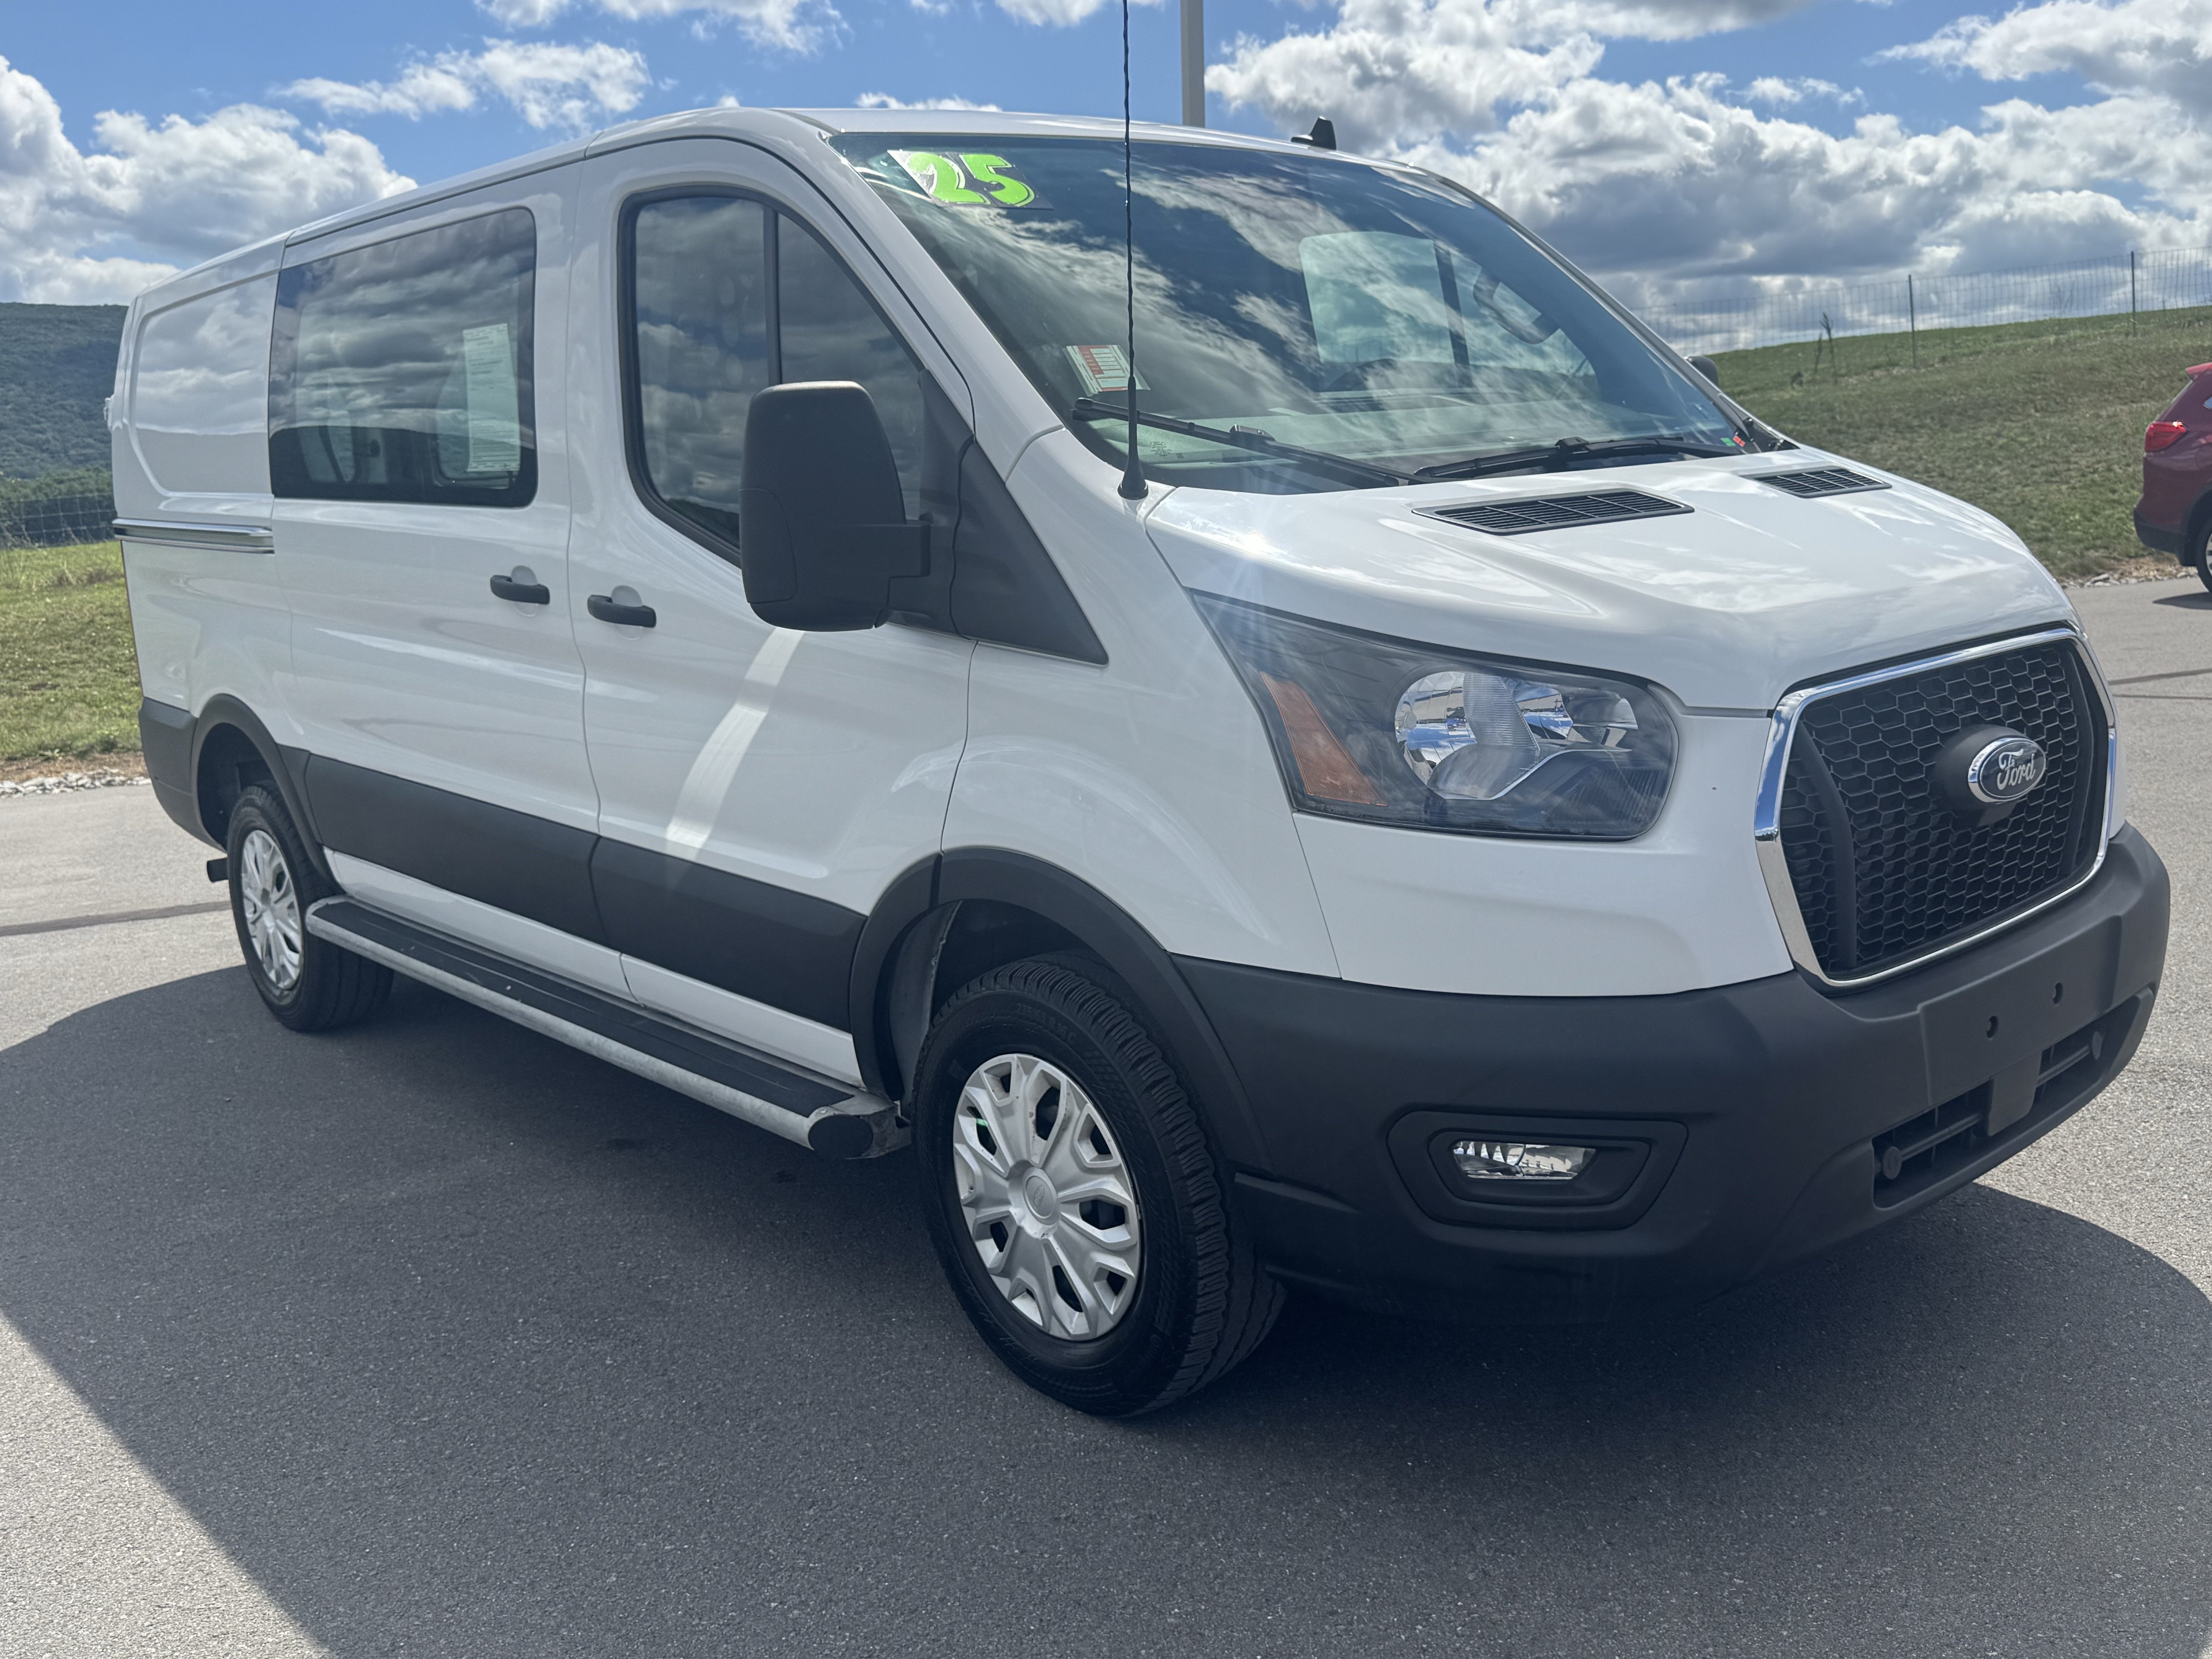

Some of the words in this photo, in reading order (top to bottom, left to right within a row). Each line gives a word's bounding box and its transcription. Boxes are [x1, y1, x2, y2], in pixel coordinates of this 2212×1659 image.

[906, 153, 1034, 207] 25
[1997, 749, 2036, 790] Ford
[1017, 1003, 1047, 1023] 235/65
